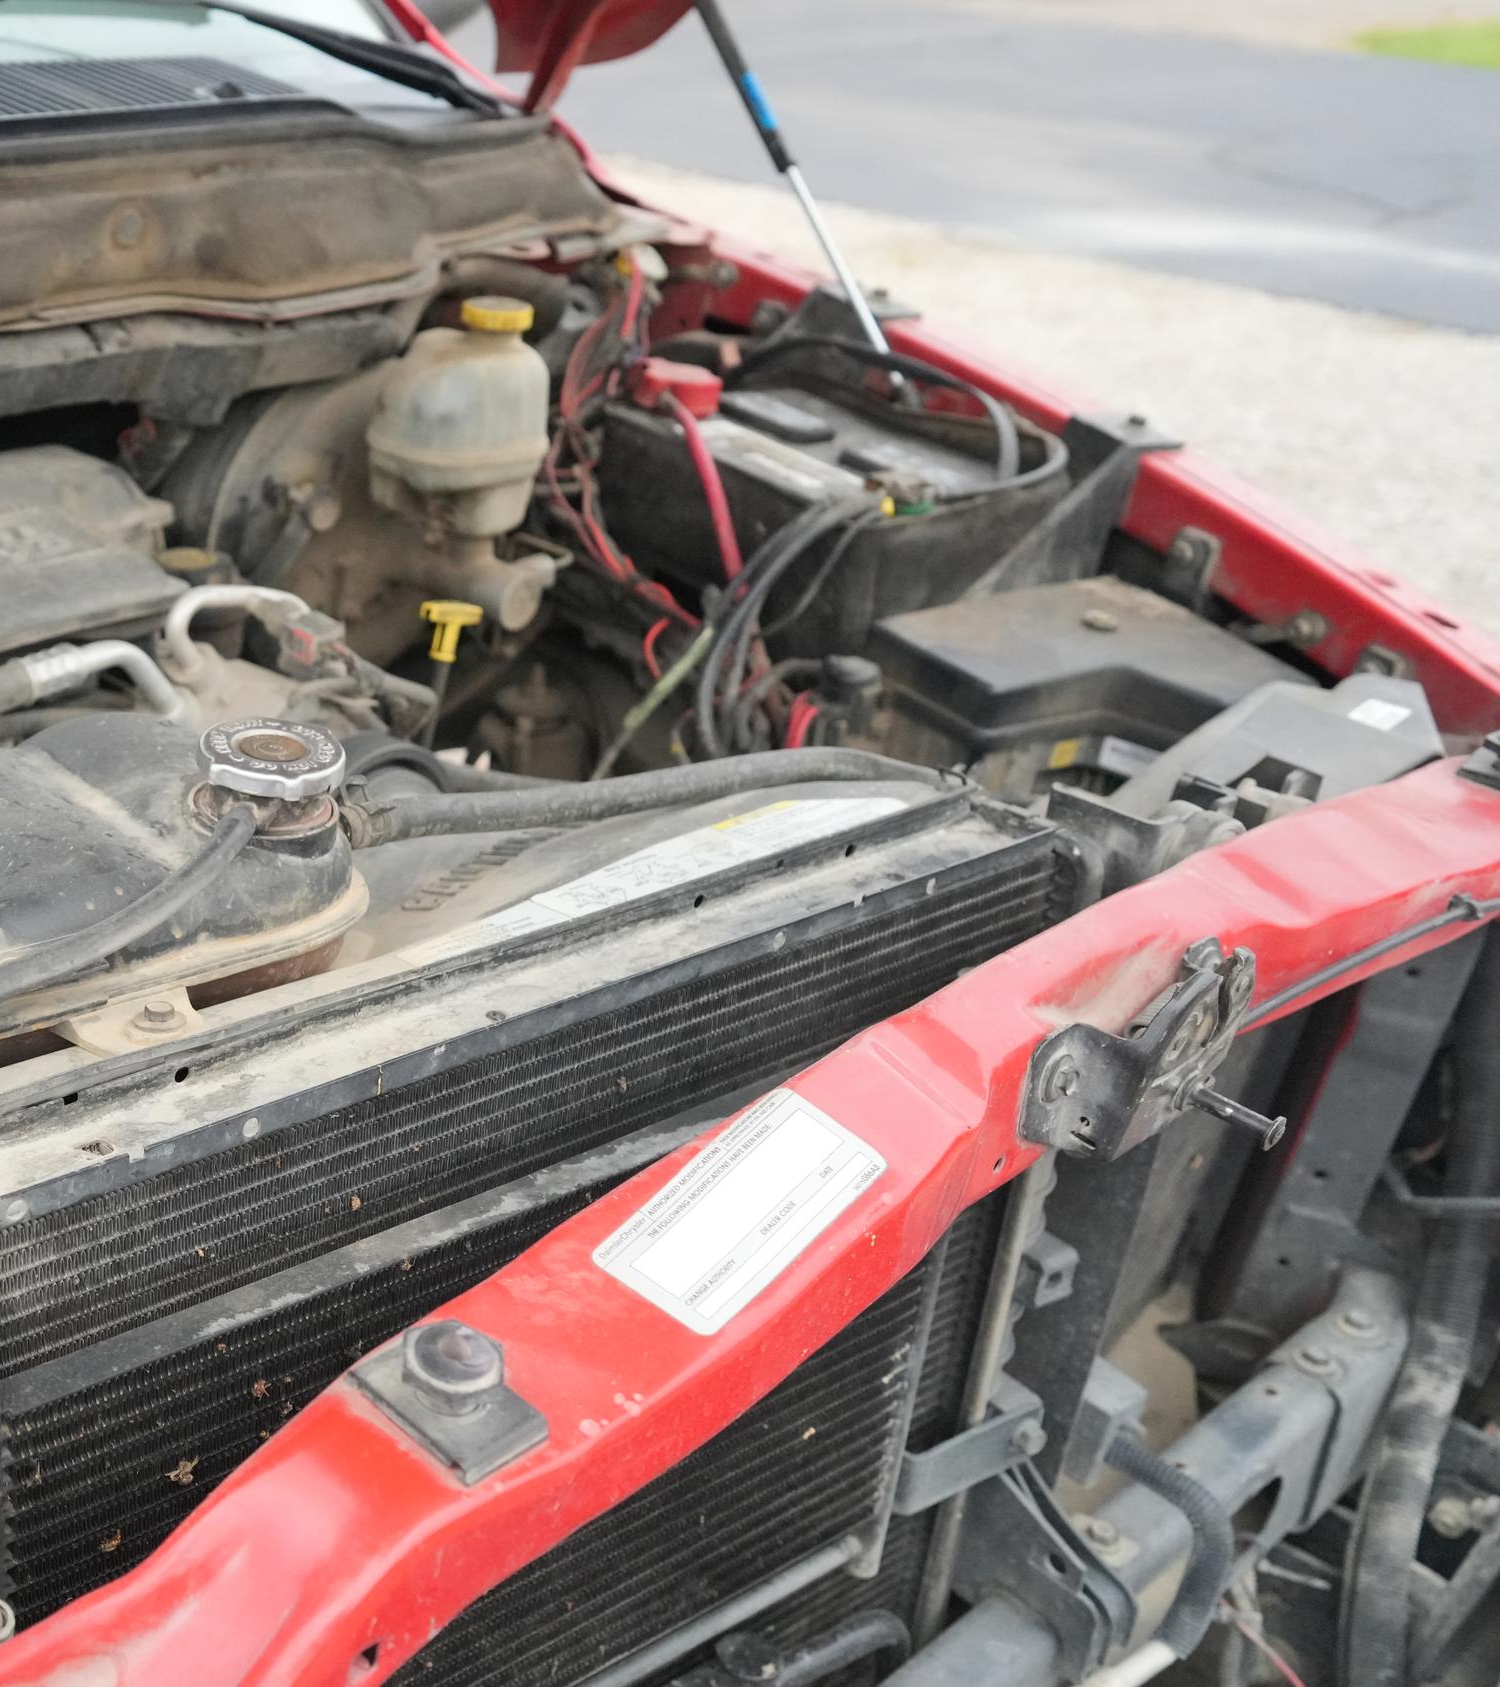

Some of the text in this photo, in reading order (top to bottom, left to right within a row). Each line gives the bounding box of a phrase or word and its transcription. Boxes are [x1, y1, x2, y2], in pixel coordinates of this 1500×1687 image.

[644, 1146, 723, 1216] AUTHORIZED MODIFICATIONS
[647, 1227, 661, 1238] THE
[655, 1199, 692, 1230] FOLLOWING
[686, 1160, 733, 1201] MODIFICATIONS
[728, 1147, 746, 1162] HAVE
[741, 1136, 757, 1150] BEEN
[817, 1164, 834, 1179] DATE
[596, 1215, 647, 1260] DaimlerChrysler
[758, 1200, 797, 1235] DEALER CODE
[683, 1257, 737, 1306] CHANGE AUTHORITY
